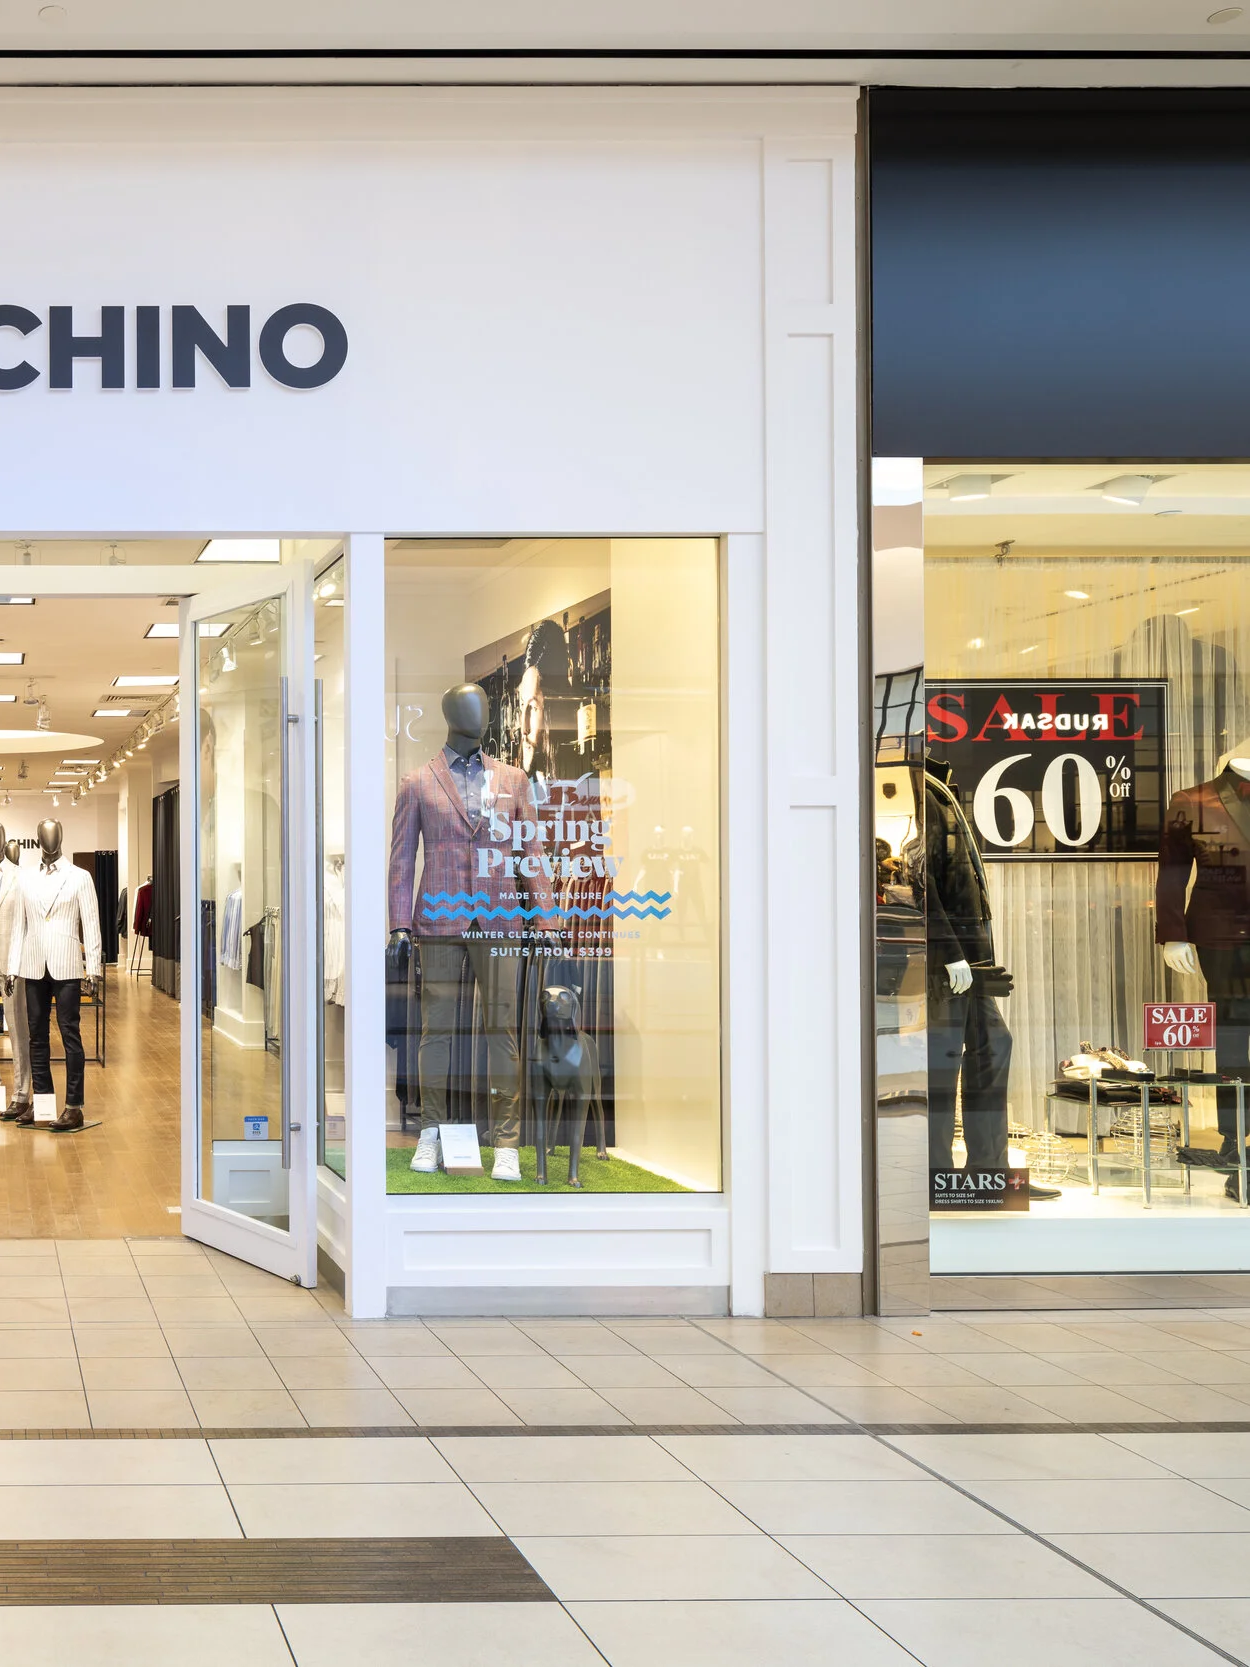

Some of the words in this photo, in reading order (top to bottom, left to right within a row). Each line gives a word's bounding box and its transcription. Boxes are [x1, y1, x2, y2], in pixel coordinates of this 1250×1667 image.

[927, 693, 1144, 743] SALE
[1110, 783, 1131, 798] Off
[973, 753, 1102, 847] 60
[489, 812, 612, 850] Spring
[476, 848, 624, 879] Preview
[499, 892, 530, 900] MADE
[533, 892, 548, 900] TO
[551, 892, 602, 900] MEASURE
[461, 931, 505, 939] WINTER
[508, 931, 574, 939] CLEARANCE
[577, 931, 641, 939] CONTINUES
[490, 947, 530, 957] SUITS
[535, 947, 574, 957] FROM
[579, 946, 612, 958] $399
[1151, 1007, 1208, 1024] SALE
[1163, 1024, 1192, 1046] 60
[934, 1173, 1006, 1190] STARS
